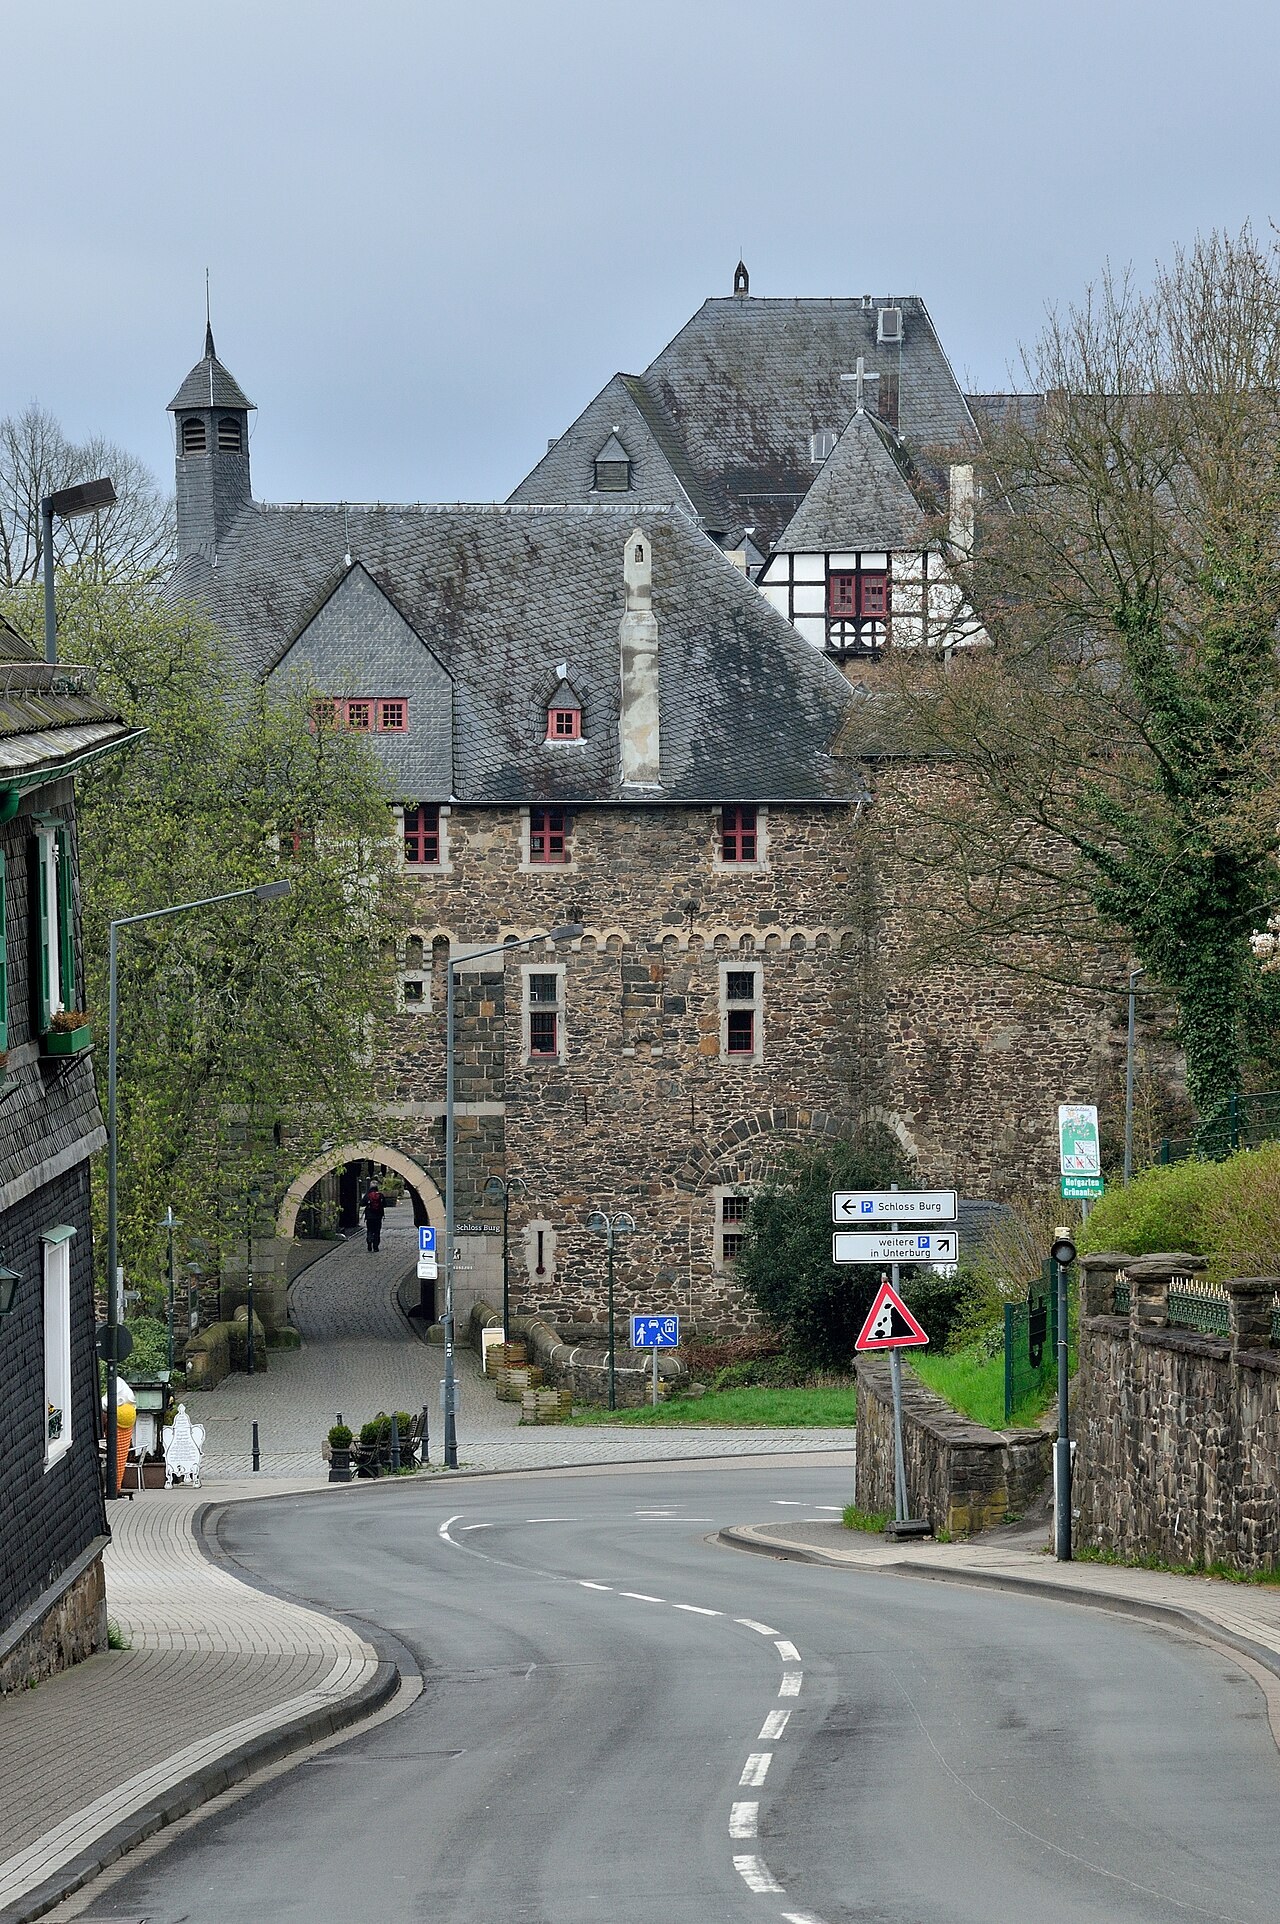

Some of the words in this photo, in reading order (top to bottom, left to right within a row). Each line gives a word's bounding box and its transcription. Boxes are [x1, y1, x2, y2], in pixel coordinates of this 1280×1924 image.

[1065, 1177, 1100, 1187] Hofgarten
[878, 1202, 915, 1211] Schloss
[919, 1202, 941, 1212] Burg
[483, 1224, 501, 1232] Burg
[422, 1229, 432, 1248] P
[878, 1238, 915, 1246] weitere
[870, 1248, 879, 1257] in
[883, 1248, 931, 1258] Unterburg
